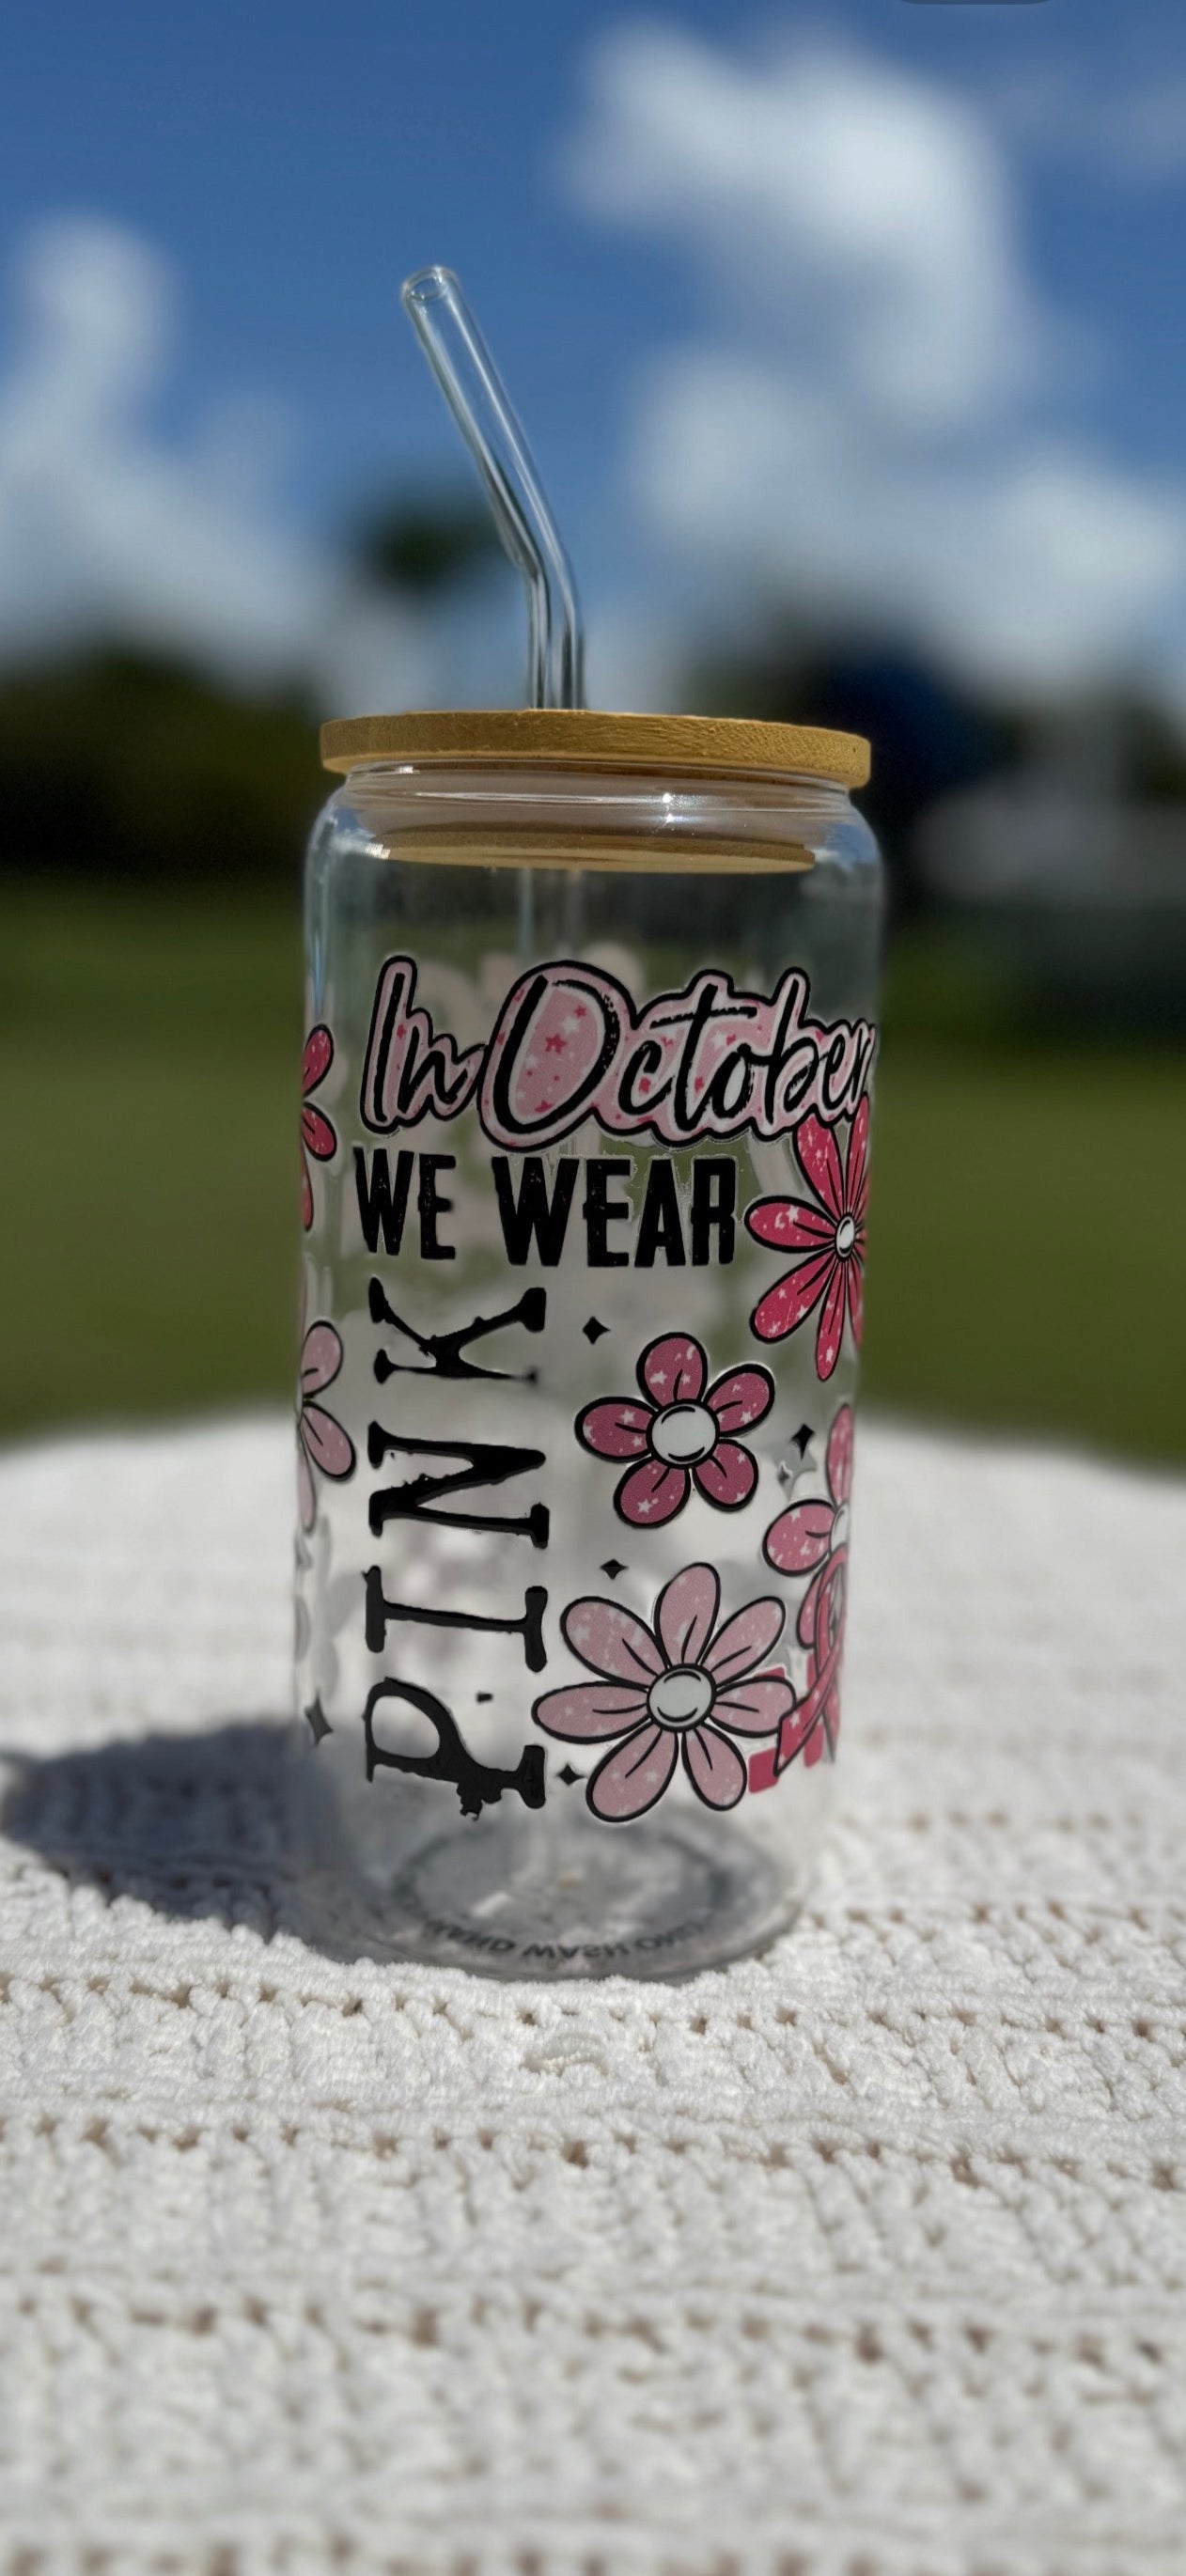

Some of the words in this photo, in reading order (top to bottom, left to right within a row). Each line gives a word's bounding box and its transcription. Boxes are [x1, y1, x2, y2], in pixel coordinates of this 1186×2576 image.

[368, 964, 482, 1129] In
[488, 969, 874, 1137] October
[353, 1147, 456, 1260] WE
[492, 1156, 736, 1268] WEAR
[363, 1277, 549, 1819] PINK
